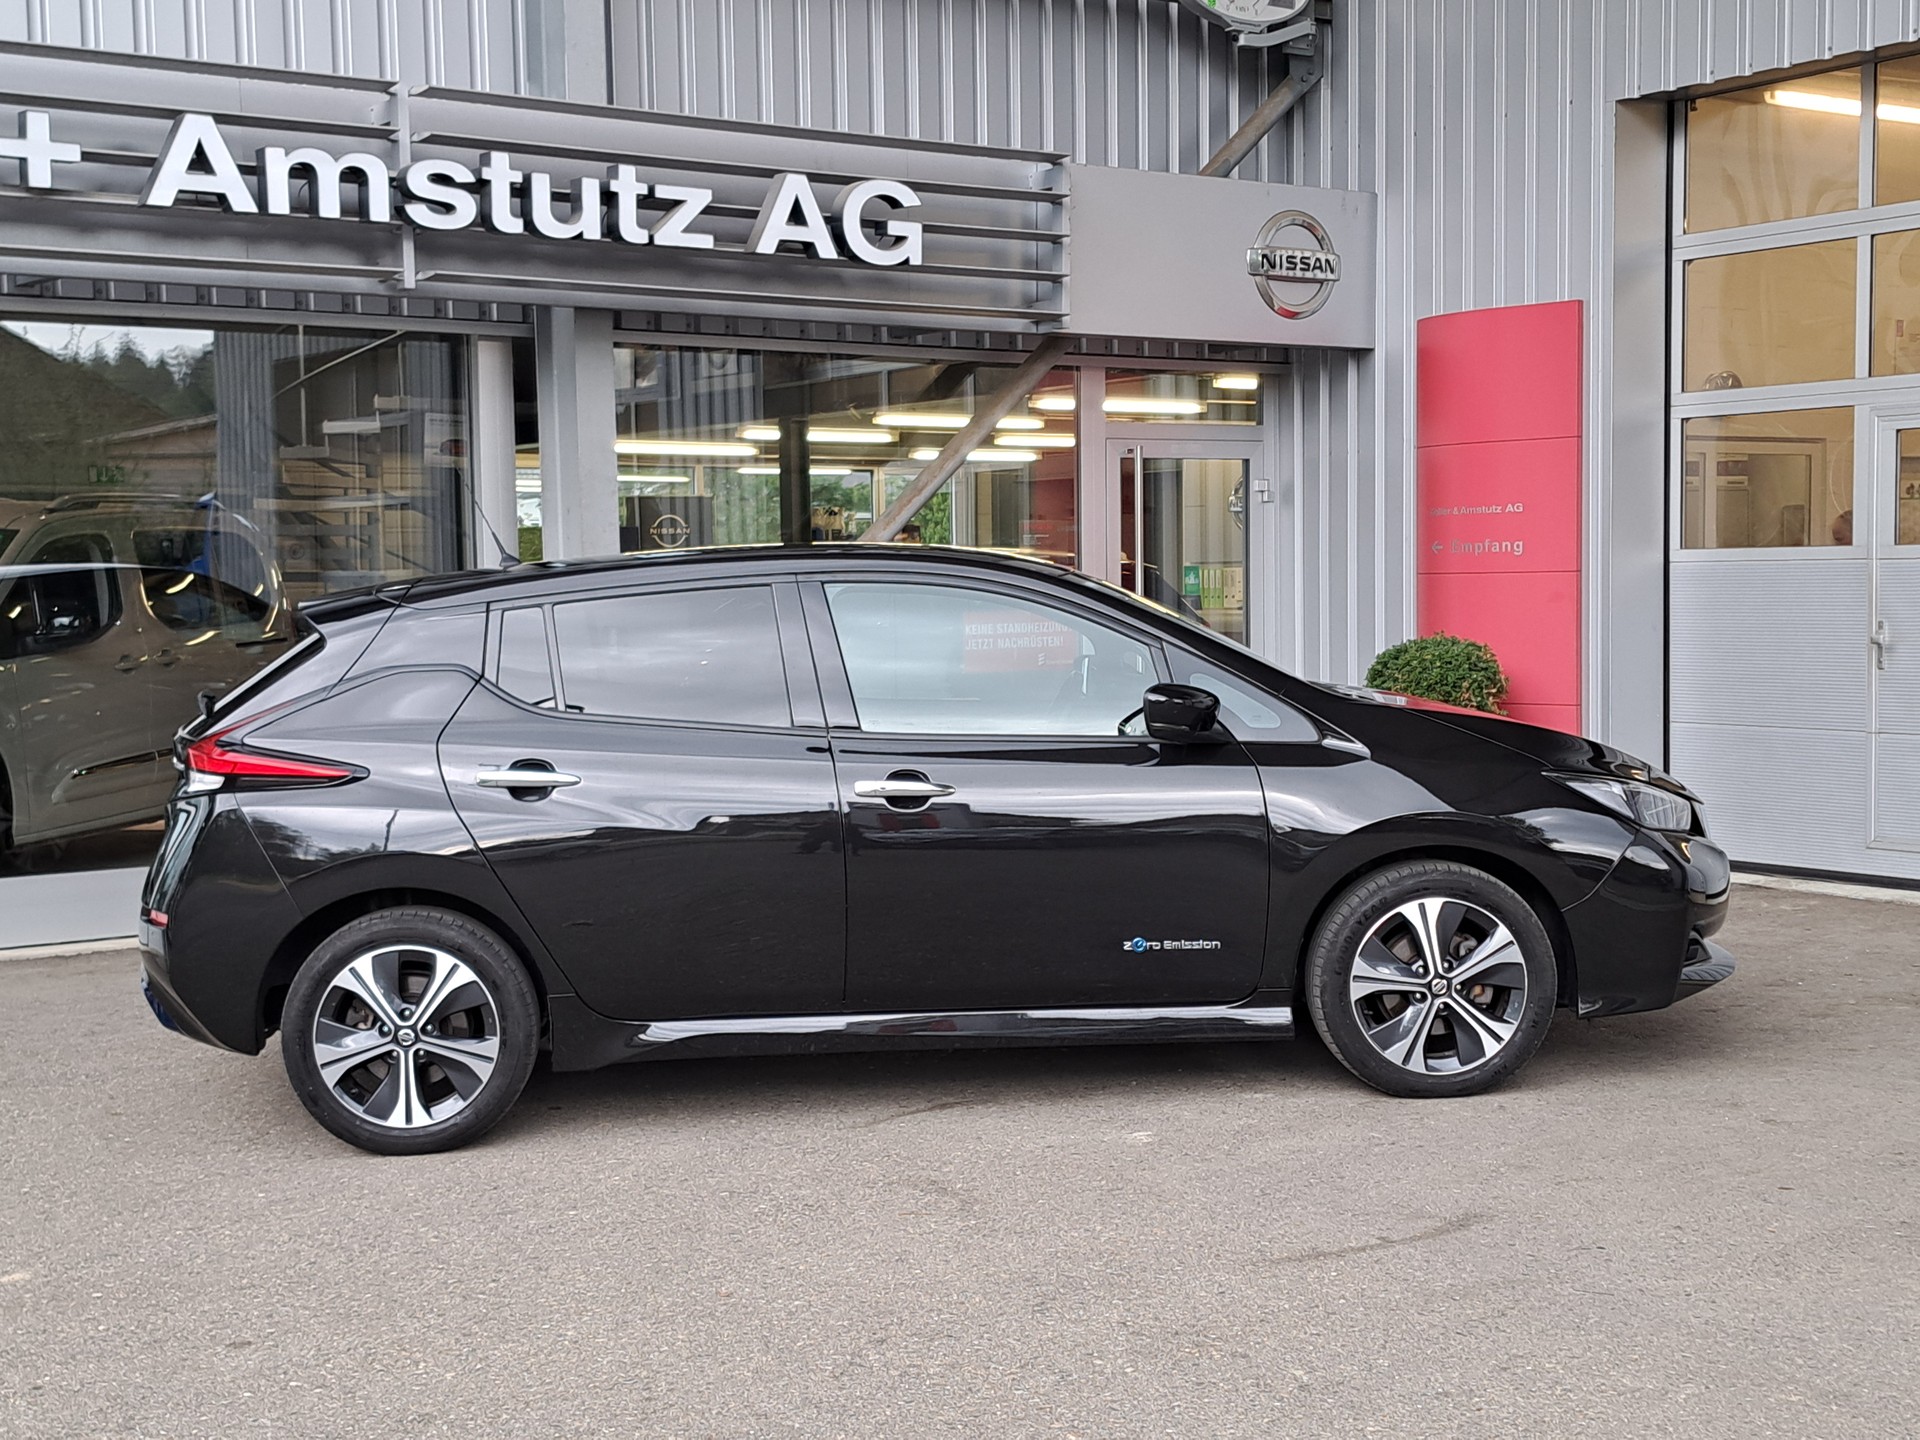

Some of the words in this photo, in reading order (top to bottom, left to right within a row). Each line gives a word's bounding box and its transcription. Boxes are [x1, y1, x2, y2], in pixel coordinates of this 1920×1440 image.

[142, 112, 714, 249] Amstutz
[750, 172, 923, 267] AG
[1260, 252, 1336, 275] NISSAN
[1460, 504, 1502, 514] Amstutz
[1505, 502, 1524, 513] AG
[649, 527, 691, 535] NISSAN
[1451, 539, 1524, 555] Empfang
[965, 623, 994, 635] KEINE
[996, 621, 1073, 634] STANDHEIZUNG
[965, 638, 994, 650] JETZT
[997, 635, 1064, 649] NACHRÜSTEN!
